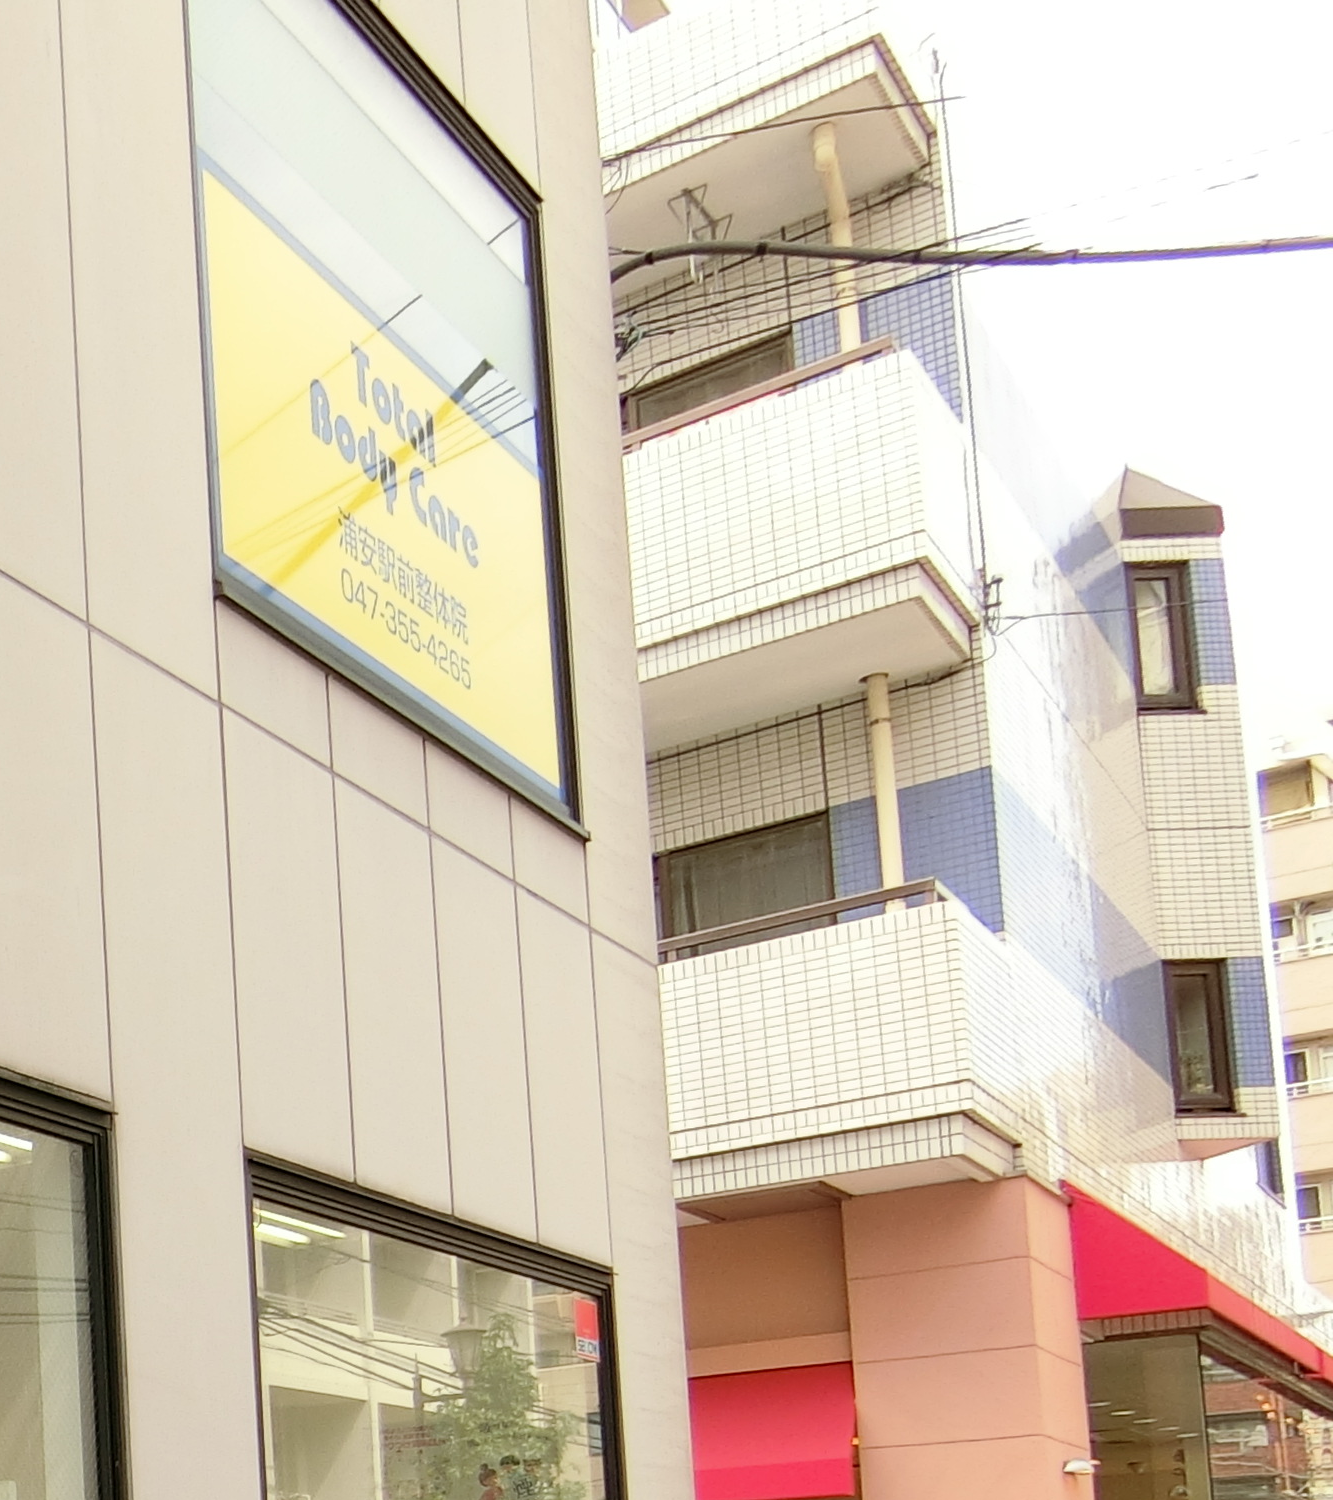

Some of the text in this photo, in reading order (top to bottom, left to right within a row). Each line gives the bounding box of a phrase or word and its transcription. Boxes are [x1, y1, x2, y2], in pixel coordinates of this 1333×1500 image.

[351, 340, 436, 468] Total
[310, 378, 479, 568] Body Care
[338, 506, 469, 645] 浦安駅前整体院
[340, 568, 472, 690] 047-355-4265
